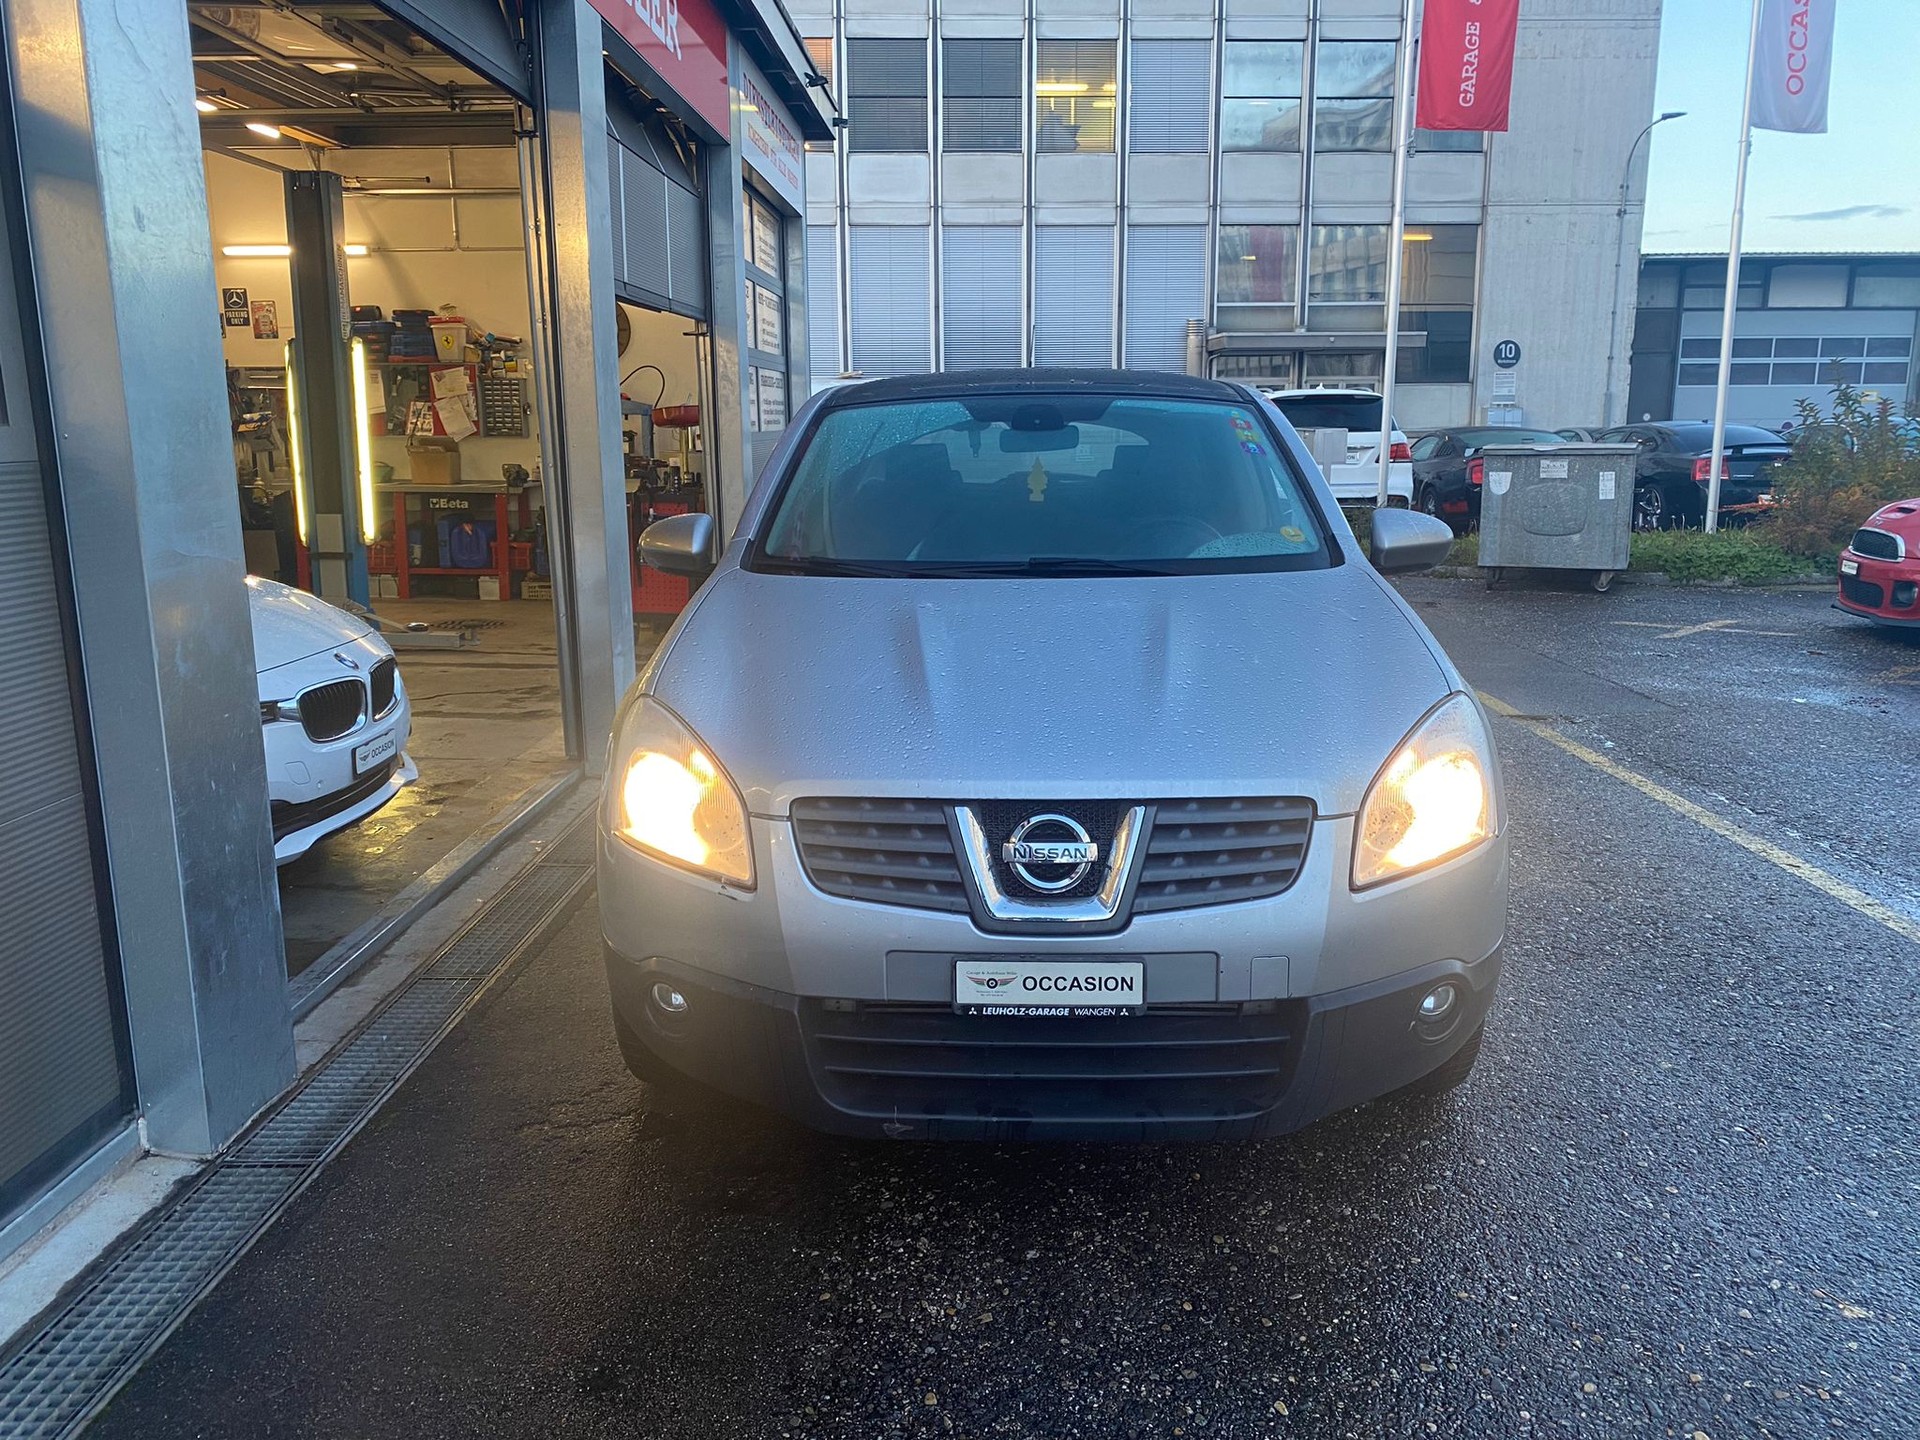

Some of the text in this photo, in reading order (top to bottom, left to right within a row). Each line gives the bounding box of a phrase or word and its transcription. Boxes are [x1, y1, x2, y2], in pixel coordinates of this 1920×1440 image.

[1459, 21, 1480, 107] GARAGE
[1499, 343, 1515, 358] 10
[440, 498, 469, 509] Beta
[371, 738, 395, 758] OCCASION
[1013, 847, 1087, 860] NISSAN
[1022, 976, 1134, 992] OCCASION
[982, 1007, 1116, 1016] LEUHOLZ-GARAGE WANGEN
